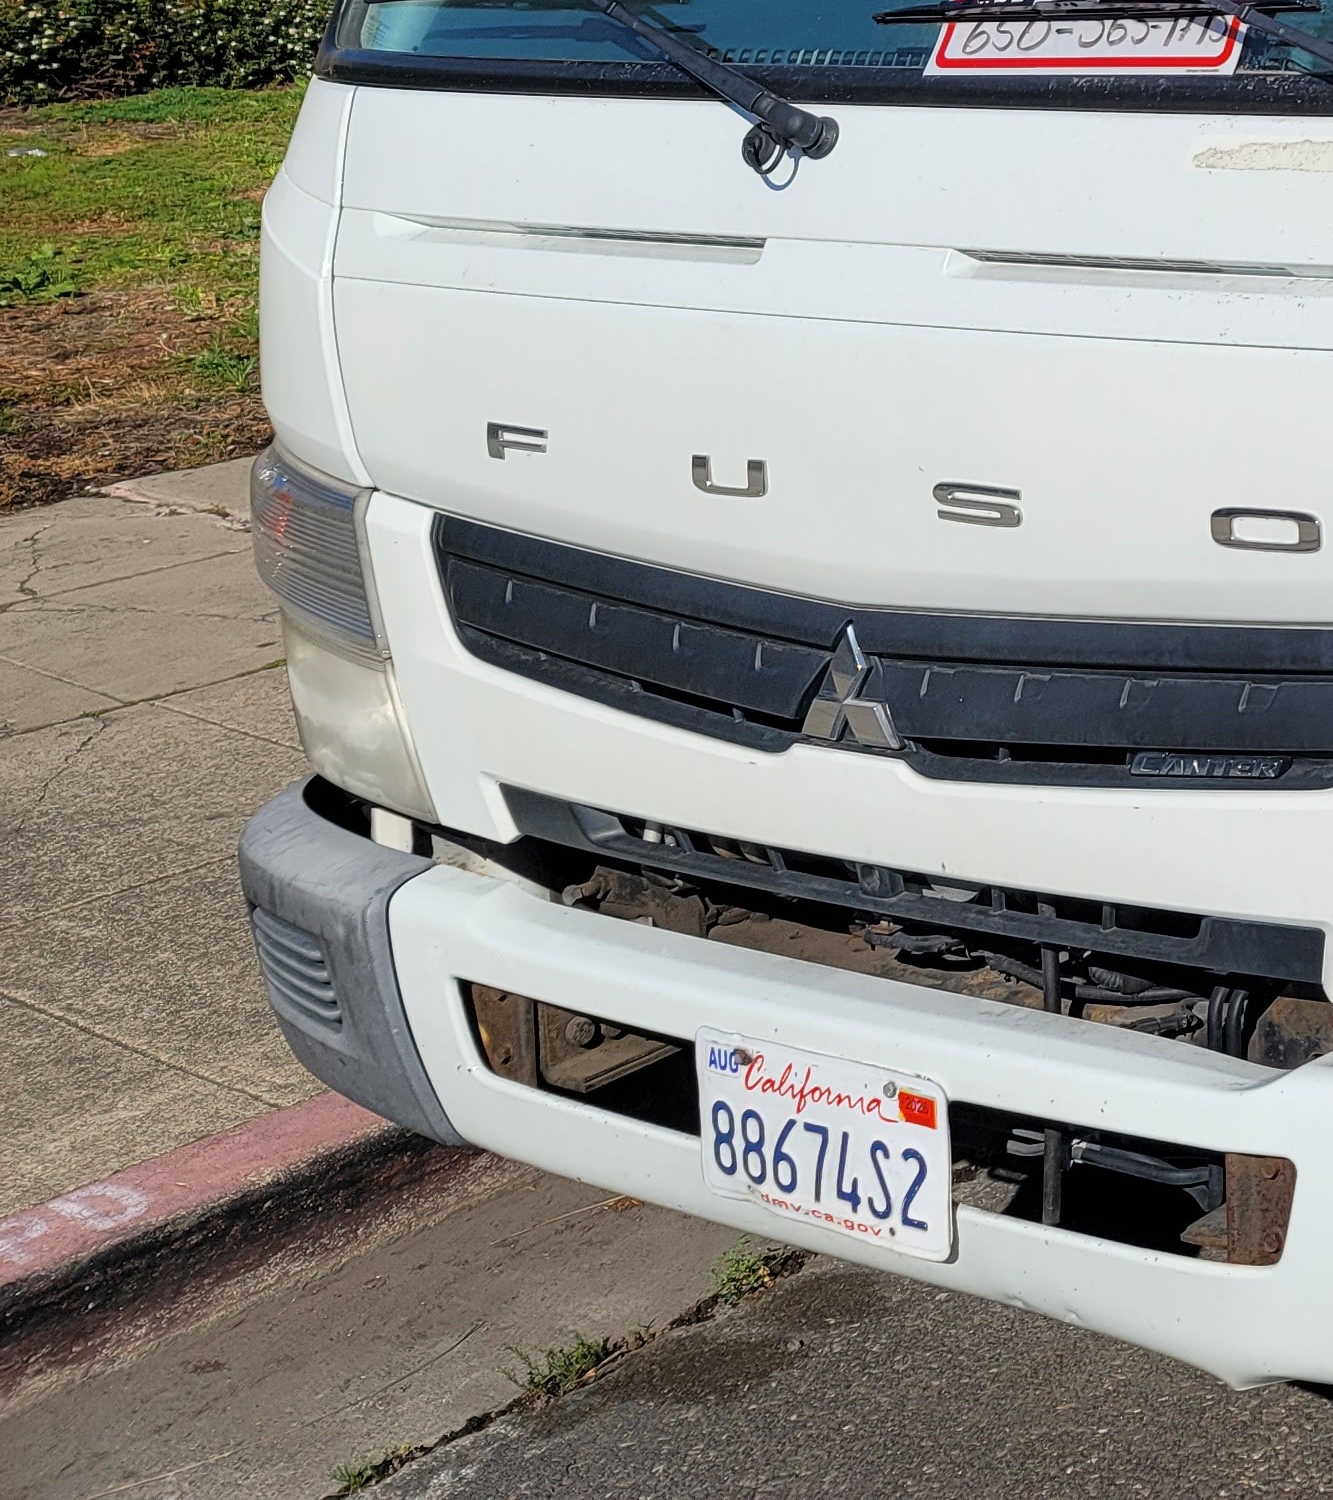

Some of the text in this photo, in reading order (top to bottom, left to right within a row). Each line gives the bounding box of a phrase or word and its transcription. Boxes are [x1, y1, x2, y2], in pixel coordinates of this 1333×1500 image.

[487, 421, 1324, 554] FUSO
[1138, 755, 1284, 777] CANTER
[709, 1047, 739, 1074] AUG
[745, 1054, 899, 1123] California
[712, 1100, 928, 1231] 88674S2
[760, 1193, 882, 1237] dmv.ca.gov
